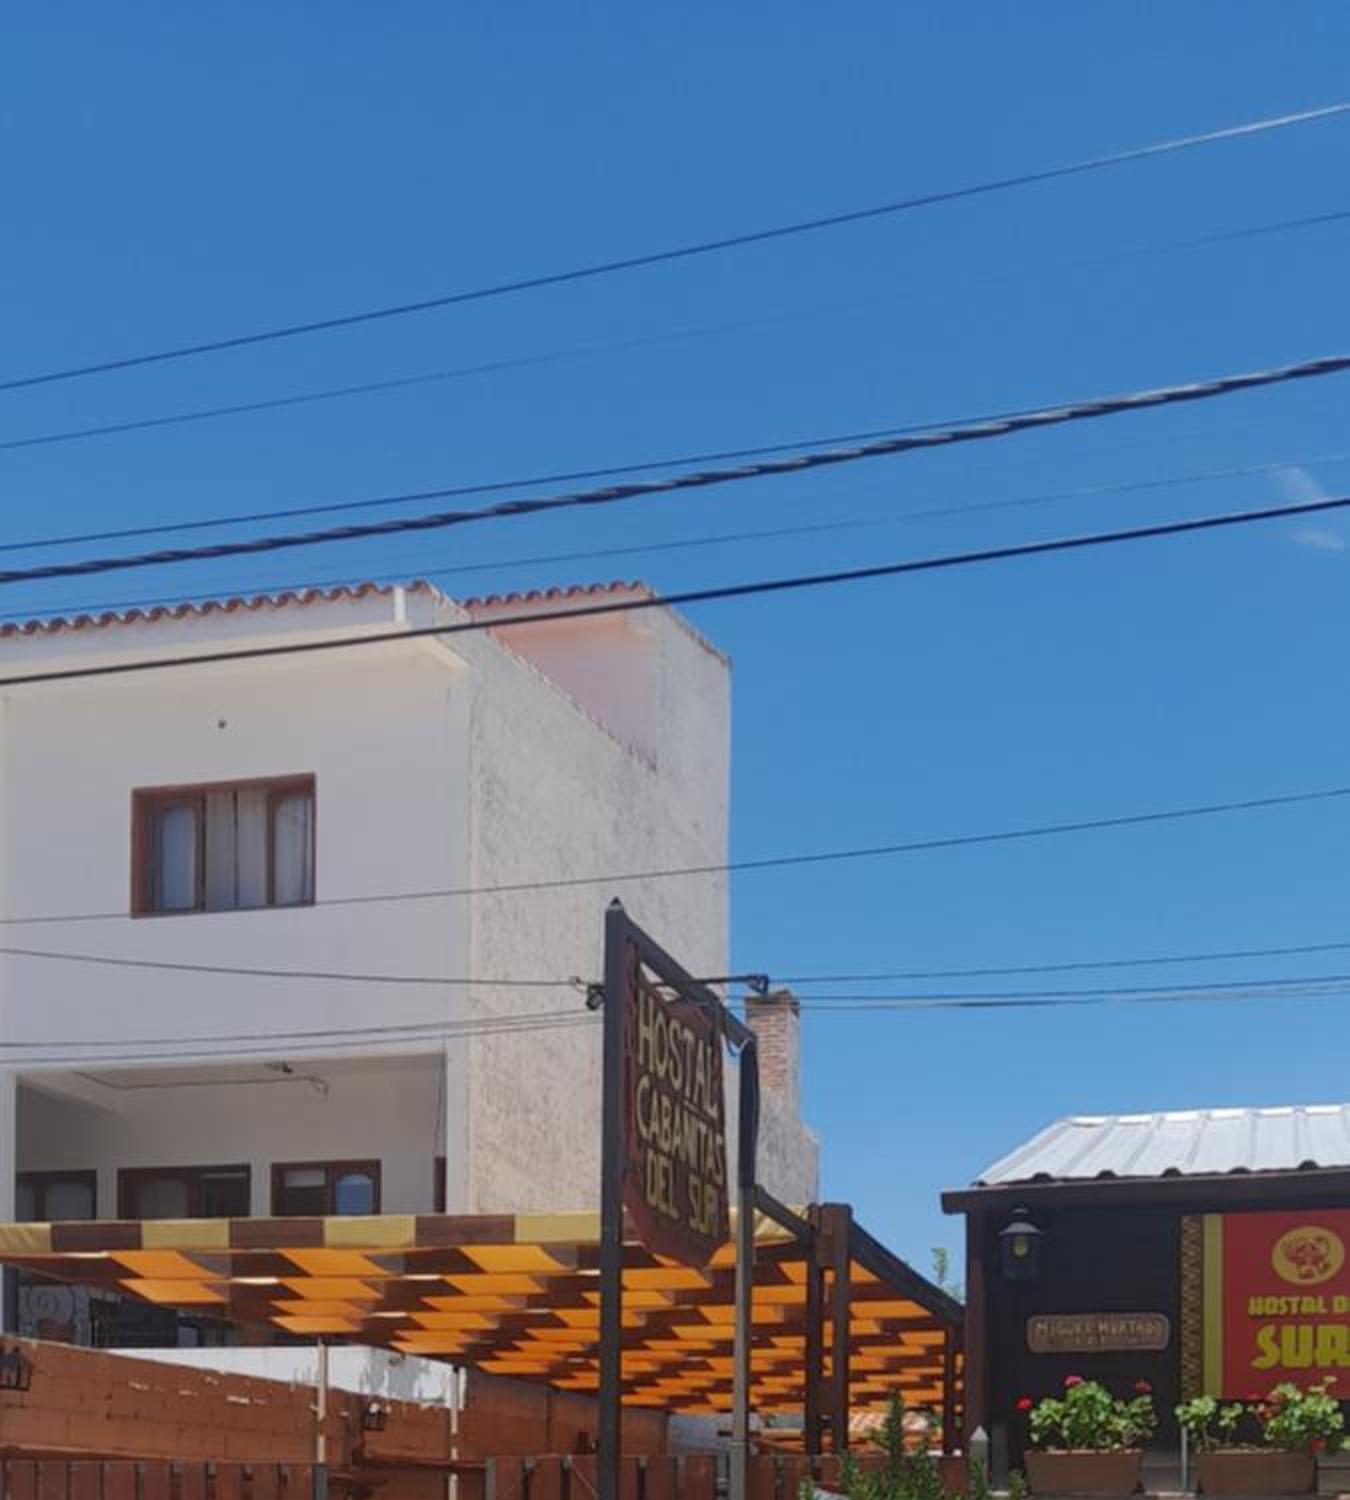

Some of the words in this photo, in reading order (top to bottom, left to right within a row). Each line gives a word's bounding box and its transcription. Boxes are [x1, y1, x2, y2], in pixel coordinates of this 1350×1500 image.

[638, 987, 719, 1119] HOSTAL
[648, 1149, 679, 1220] DEL
[689, 1173, 719, 1237] SUR
[1248, 1295, 1328, 1315] HOSTAL
